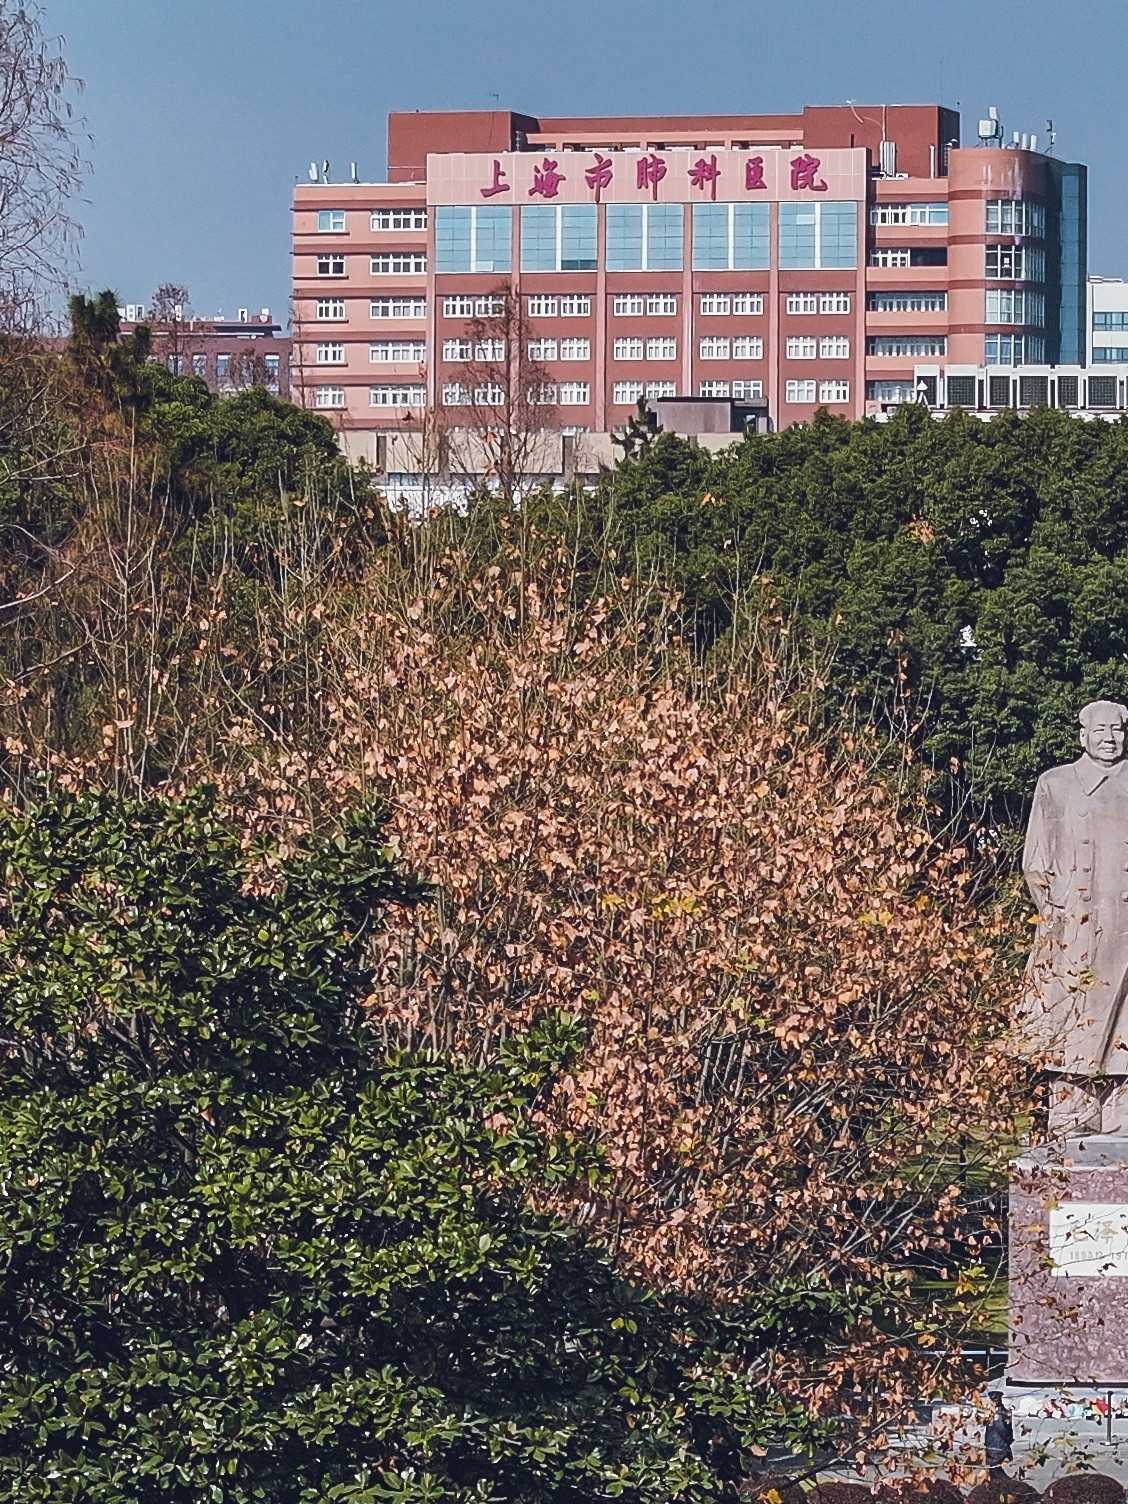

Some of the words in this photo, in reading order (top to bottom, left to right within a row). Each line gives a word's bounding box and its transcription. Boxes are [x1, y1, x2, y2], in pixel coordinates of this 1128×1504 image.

[480, 152, 828, 203] 上海市肺科医院
